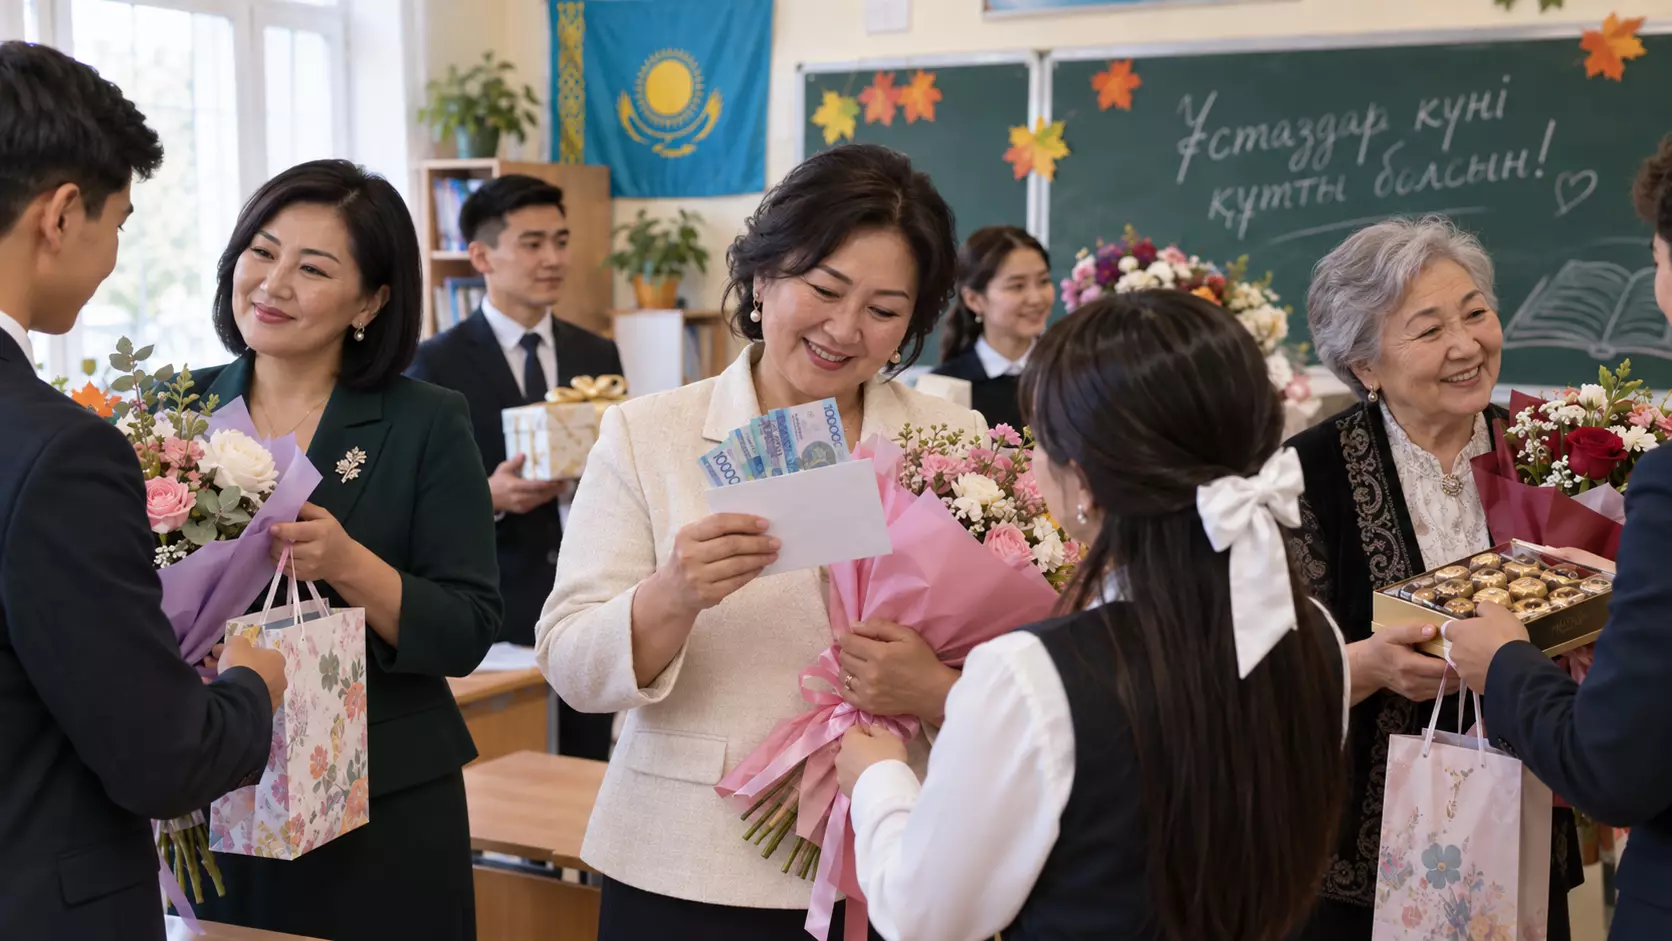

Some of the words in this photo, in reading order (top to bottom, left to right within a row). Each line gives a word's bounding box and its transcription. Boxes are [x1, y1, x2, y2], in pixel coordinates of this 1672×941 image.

[1176, 89, 1390, 185] Ұстаздар
[1208, 174, 1347, 240] құтты
[1374, 118, 1557, 198] болсын!
